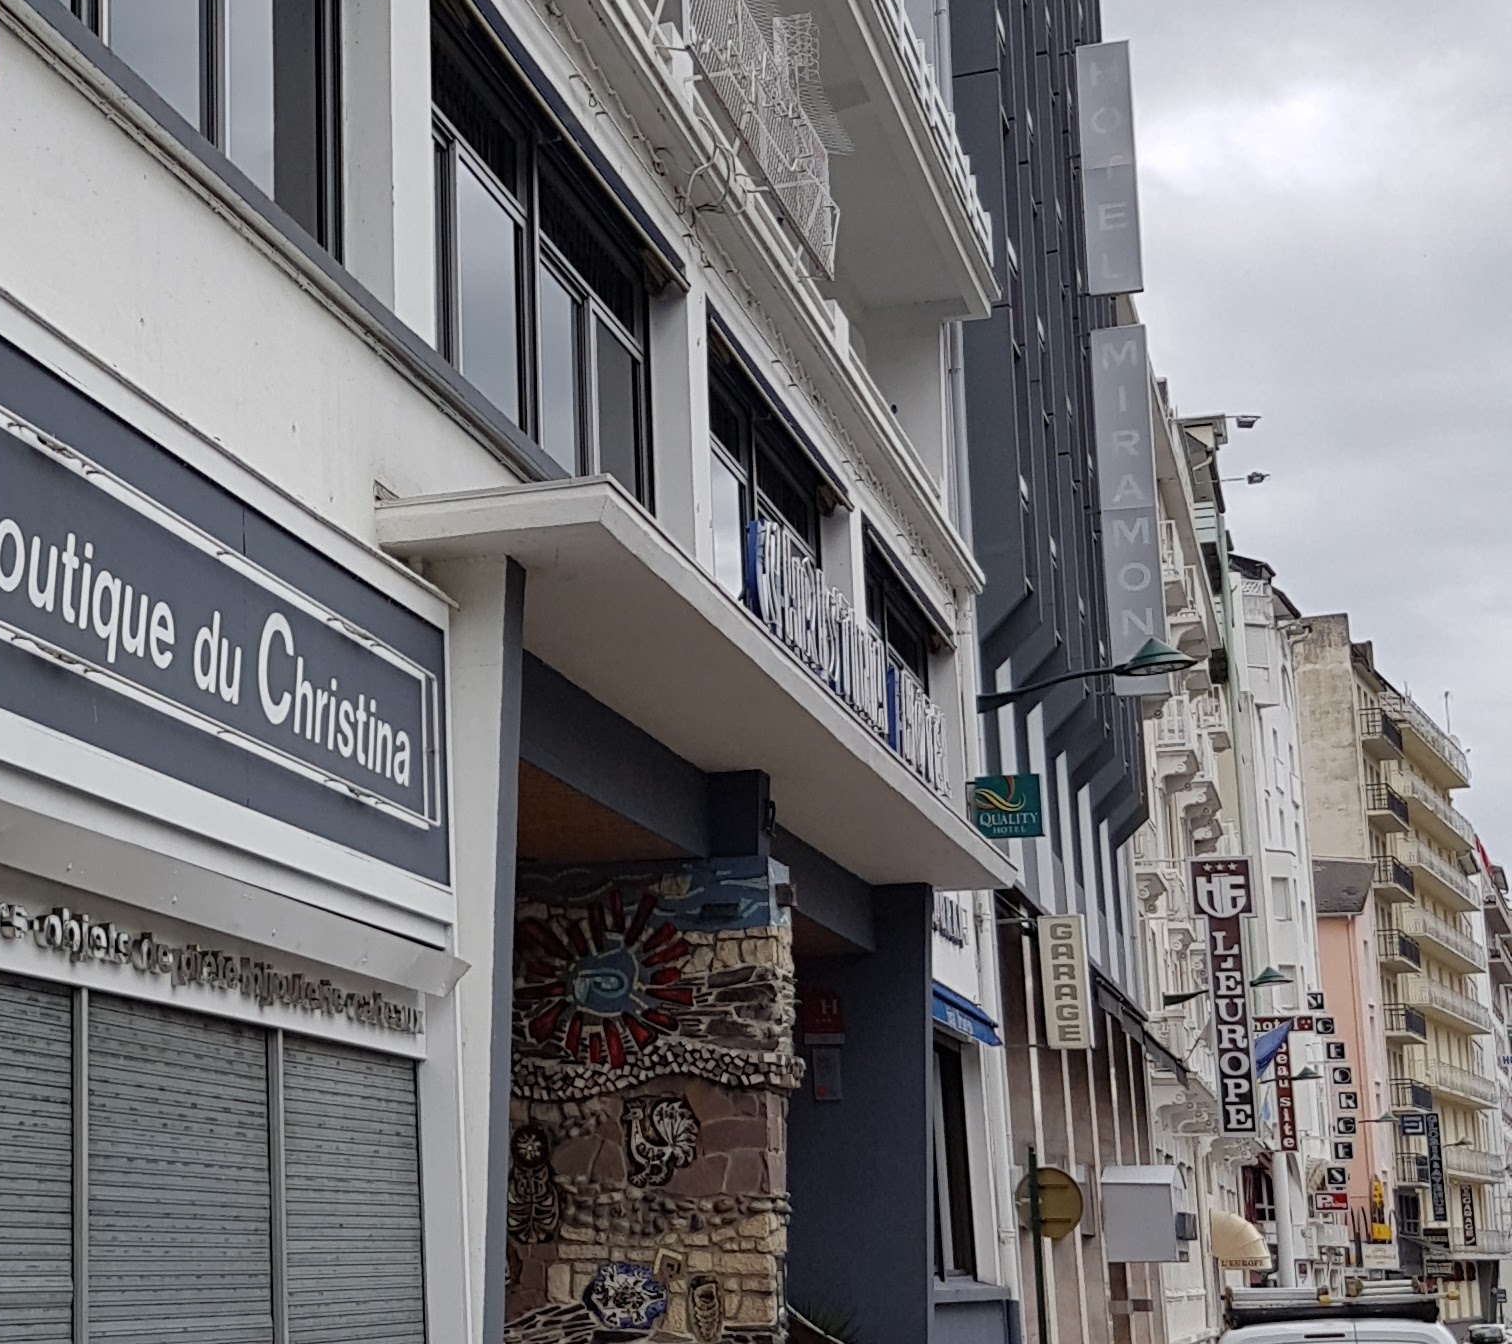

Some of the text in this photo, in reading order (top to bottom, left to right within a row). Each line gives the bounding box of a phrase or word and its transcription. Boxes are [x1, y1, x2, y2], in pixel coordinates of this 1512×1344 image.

[1100, 337, 1155, 637] MIRAMON
[193, 609, 243, 706] du
[258, 612, 411, 788] Christina
[979, 811, 1039, 828] QUALITY
[992, 825, 1027, 834] HOTEL
[1050, 923, 1082, 1042] GARAGE
[1252, 1016, 1300, 1031] hotl
[1212, 931, 1254, 1131] L'EUROPE
[1278, 1096, 1296, 1149] site
